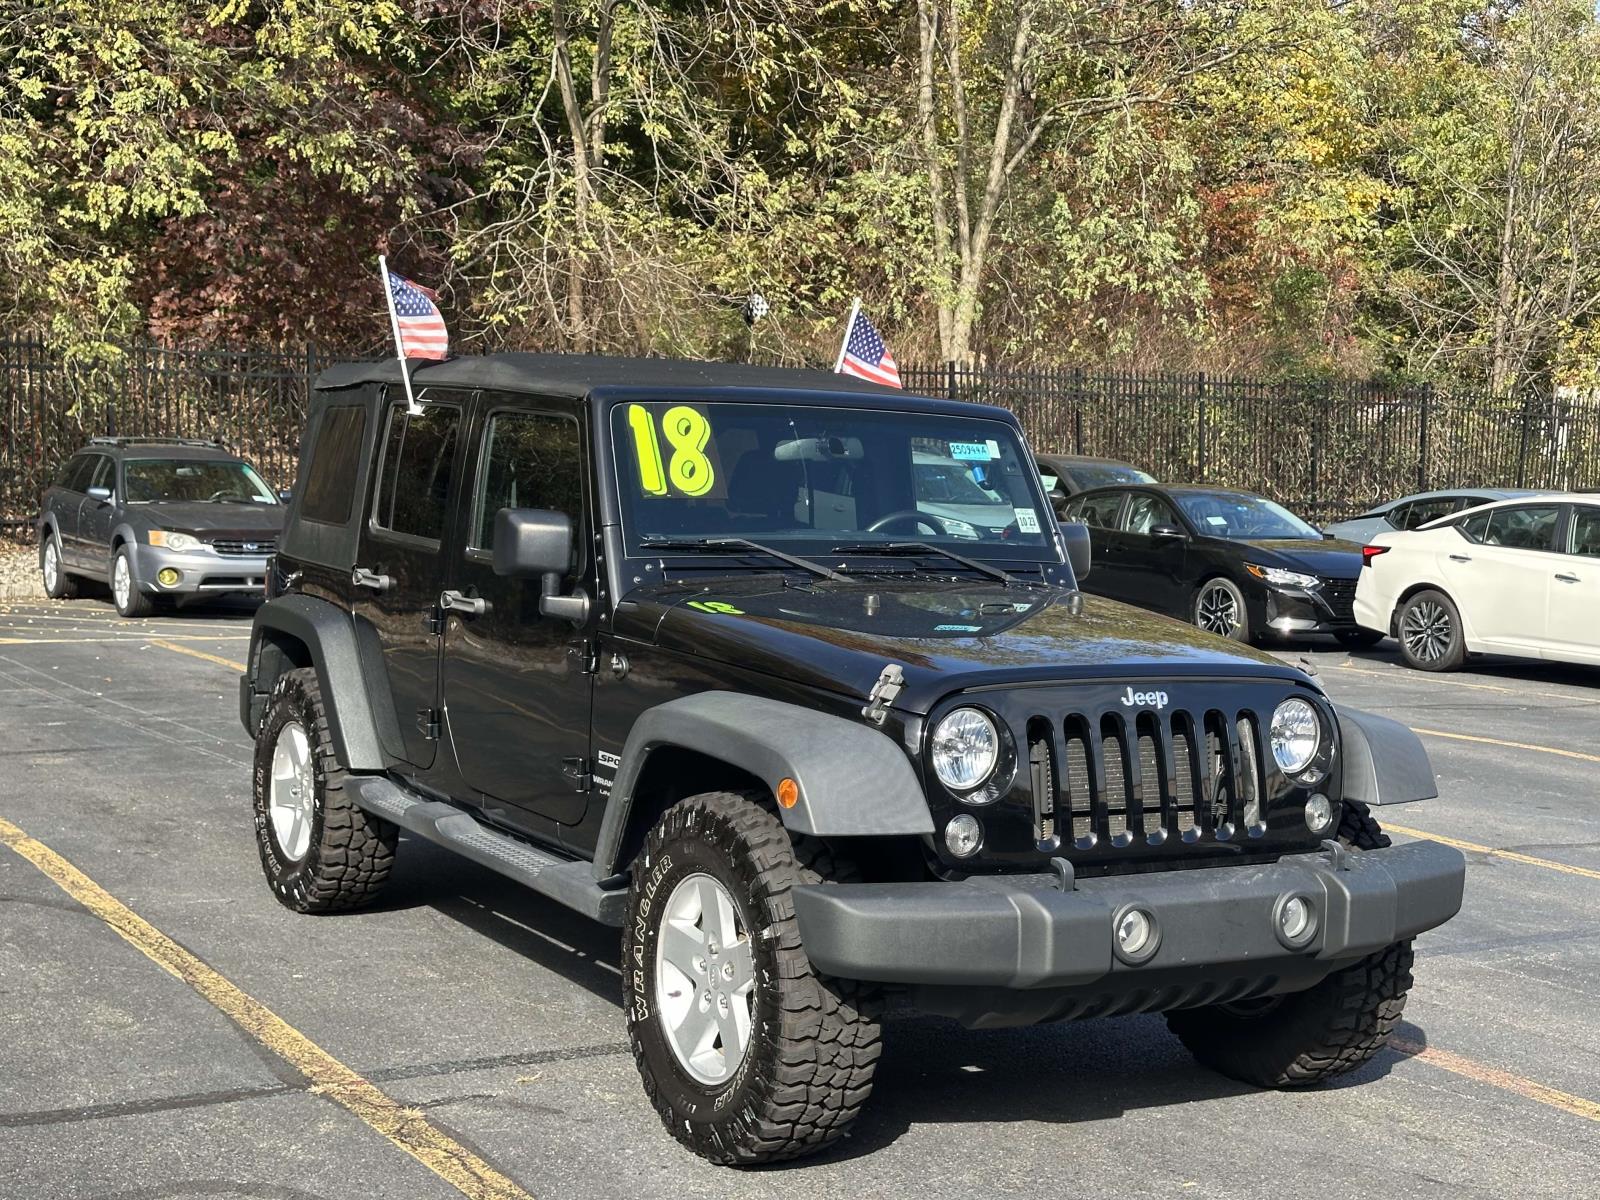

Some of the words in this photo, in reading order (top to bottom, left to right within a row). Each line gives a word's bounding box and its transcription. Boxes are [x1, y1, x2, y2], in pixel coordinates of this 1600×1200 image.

[629, 404, 715, 496] 18
[1120, 686, 1169, 710] Jeep
[600, 754, 620, 766] SPO
[633, 854, 673, 1022] WRANGLER
